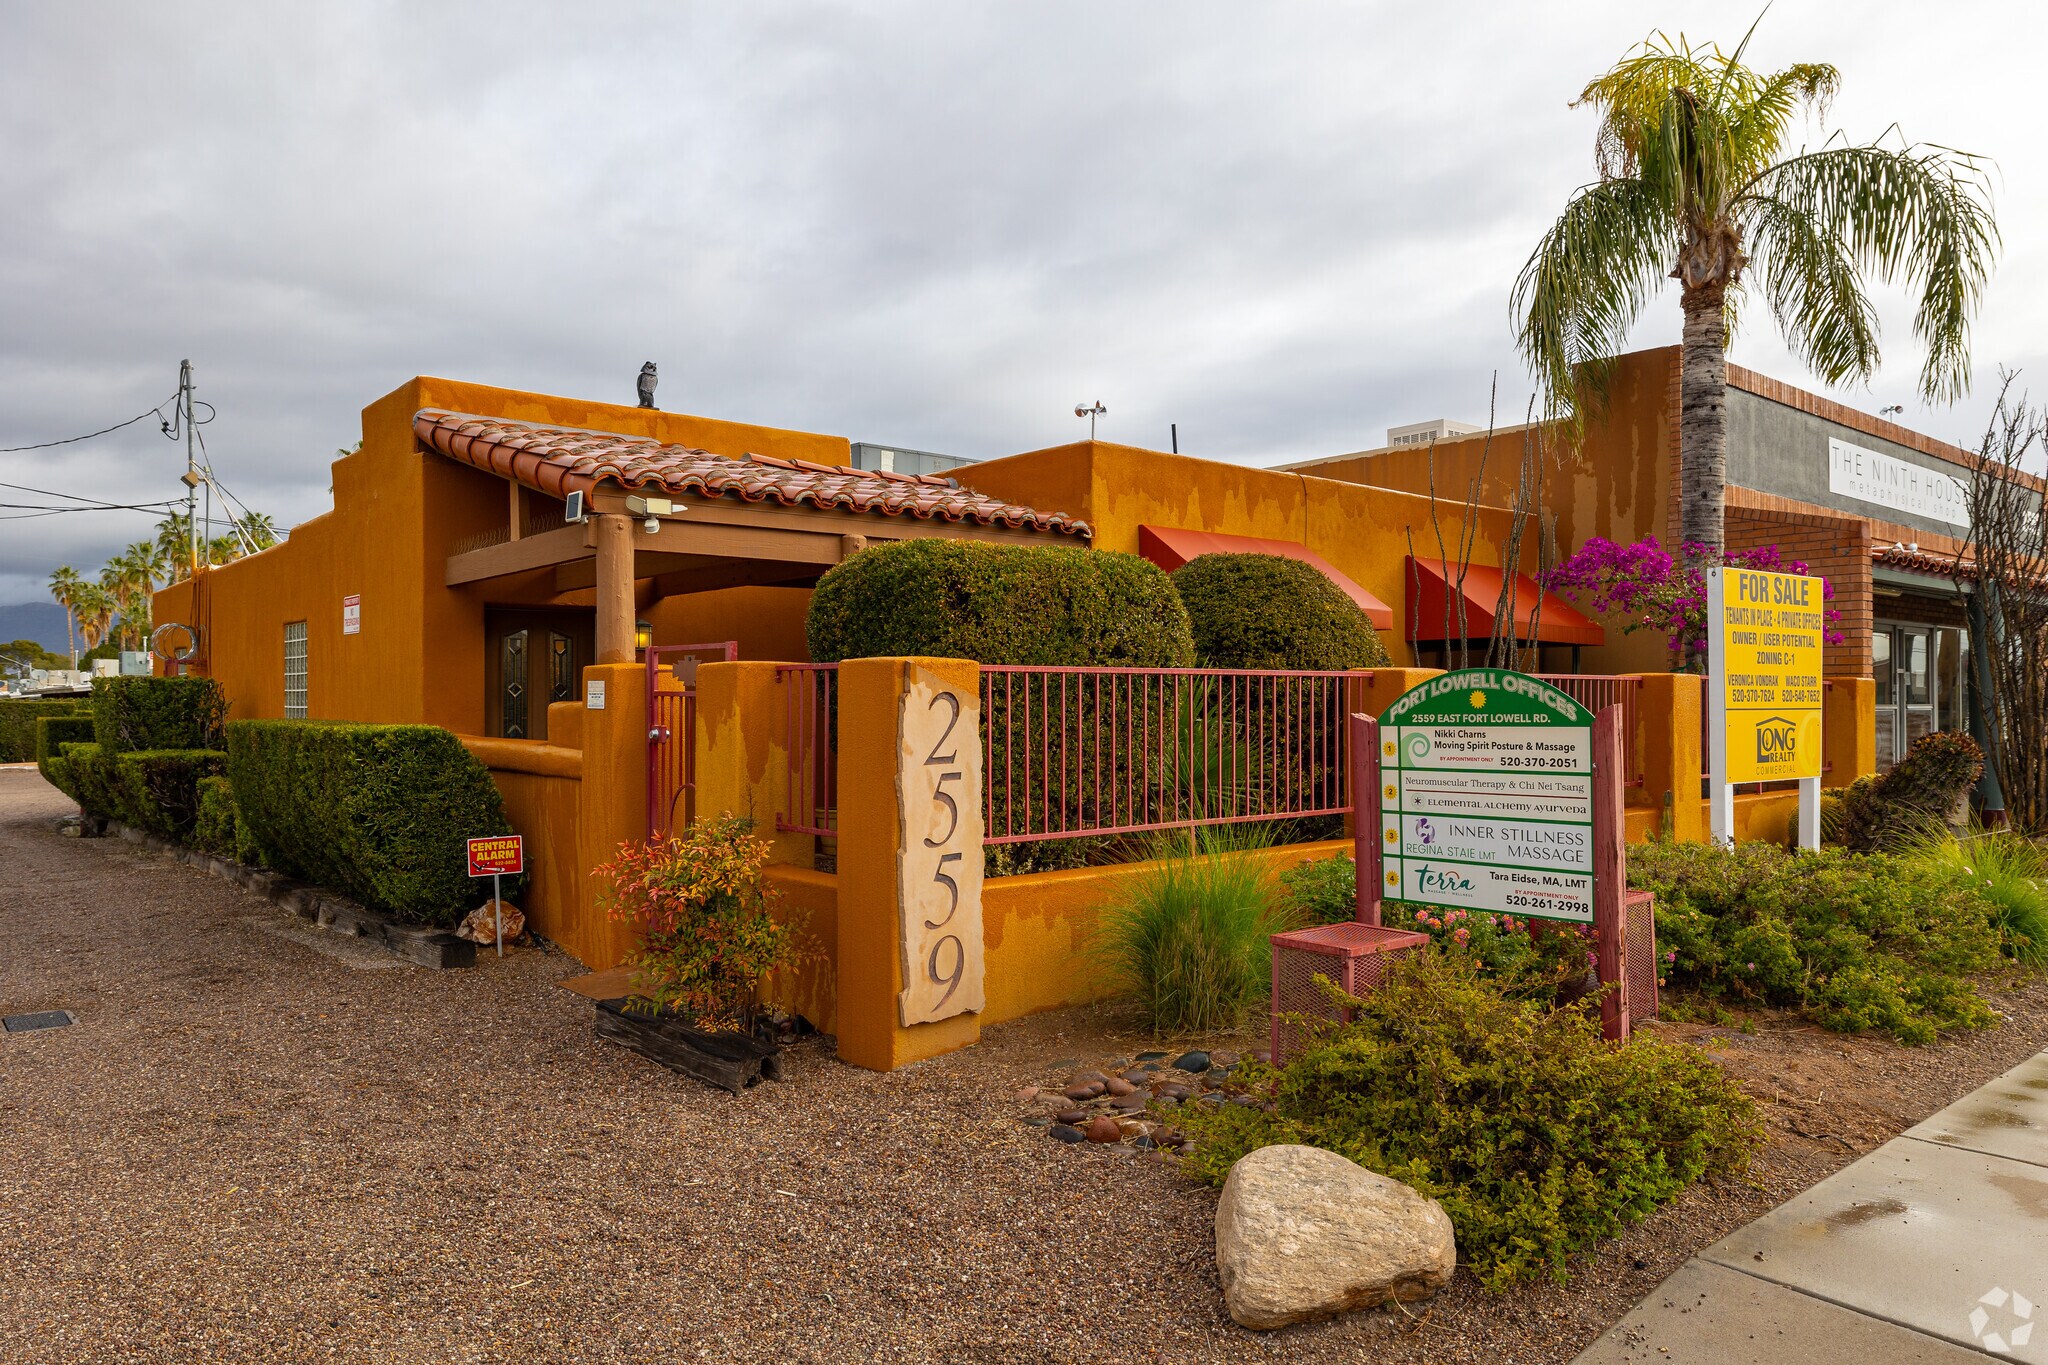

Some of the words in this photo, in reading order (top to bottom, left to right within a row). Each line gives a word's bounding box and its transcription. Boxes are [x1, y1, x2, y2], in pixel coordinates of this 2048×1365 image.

[1832, 446, 1862, 476] THE
[1872, 459, 1918, 492] NINTH
[1849, 480, 1927, 511] metaphysical
[1933, 503, 1956, 519] shop
[1739, 573, 1769, 603] FOR
[1774, 577, 1809, 606] SALE
[1725, 606, 1749, 625] TENANTS
[1750, 608, 1756, 626] IN
[1757, 609, 1773, 627] PLACE
[1777, 611, 1781, 628] 4
[1781, 610, 1801, 629] PRIVATE
[1802, 612, 1821, 630] OFFICES
[1732, 631, 1757, 645] OWNER
[1758, 633, 1762, 646] /
[1763, 633, 1780, 646] USER
[1782, 633, 1816, 648] POTENTIAL
[1757, 651, 1782, 665] ZONING
[1784, 652, 1795, 665] C-1
[1727, 674, 1754, 686] VERONICA
[1755, 675, 1779, 686] VONDRAK
[1785, 675, 1800, 687] WACO
[1801, 676, 1817, 687] STARR
[1389, 684, 1430, 724] FORT
[1430, 672, 1500, 698] LOWELL
[1501, 674, 1578, 722] OFFICES
[1732, 689, 1775, 702] 520-370-7624
[1411, 714, 1435, 723] 2559
[1437, 714, 1461, 723] EAST
[1463, 714, 1488, 723] FORT
[1490, 714, 1532, 723] LOWELL
[1533, 714, 1551, 723] RD.
[1434, 729, 1456, 738] Nikki
[1457, 730, 1486, 739] Charns
[1434, 741, 1465, 751] Moving
[1466, 741, 1490, 752] Spirit
[1491, 742, 1524, 752] Posture
[1526, 742, 1534, 751] &
[1535, 743, 1576, 754] Massage
[1756, 727, 1796, 763] LONG
[1500, 756, 1578, 768] 520-370-2051
[1770, 751, 1796, 763] REALTY
[1756, 764, 1796, 776] COMMERCIAL
[1405, 777, 1469, 787] Neuromuscular
[1470, 779, 1507, 790] Therapy
[1508, 781, 1516, 789] &
[1518, 781, 1535, 790] Chi
[1537, 782, 1553, 791] Nei
[1555, 783, 1585, 794] Tsang
[1389, 832, 1394, 840] 3
[1449, 824, 1495, 840] INNER
[1501, 828, 1584, 846] STILLNESS
[470, 840, 519, 852] CENTRAL
[1406, 843, 1443, 856] REGINA
[1447, 846, 1475, 859] STAIE
[1478, 850, 1496, 860] LMT
[1507, 845, 1584, 863] MASSAGE
[476, 849, 515, 861] ALARM
[1414, 863, 1476, 894] terra
[1489, 871, 1509, 881] Tara
[1511, 874, 1540, 885] Eidse,
[1542, 876, 1563, 887] MA,
[1565, 878, 1587, 888] LMT
[1523, 890, 1563, 899] APPOINTMENT
[1506, 895, 1589, 913] 520-261-2998
